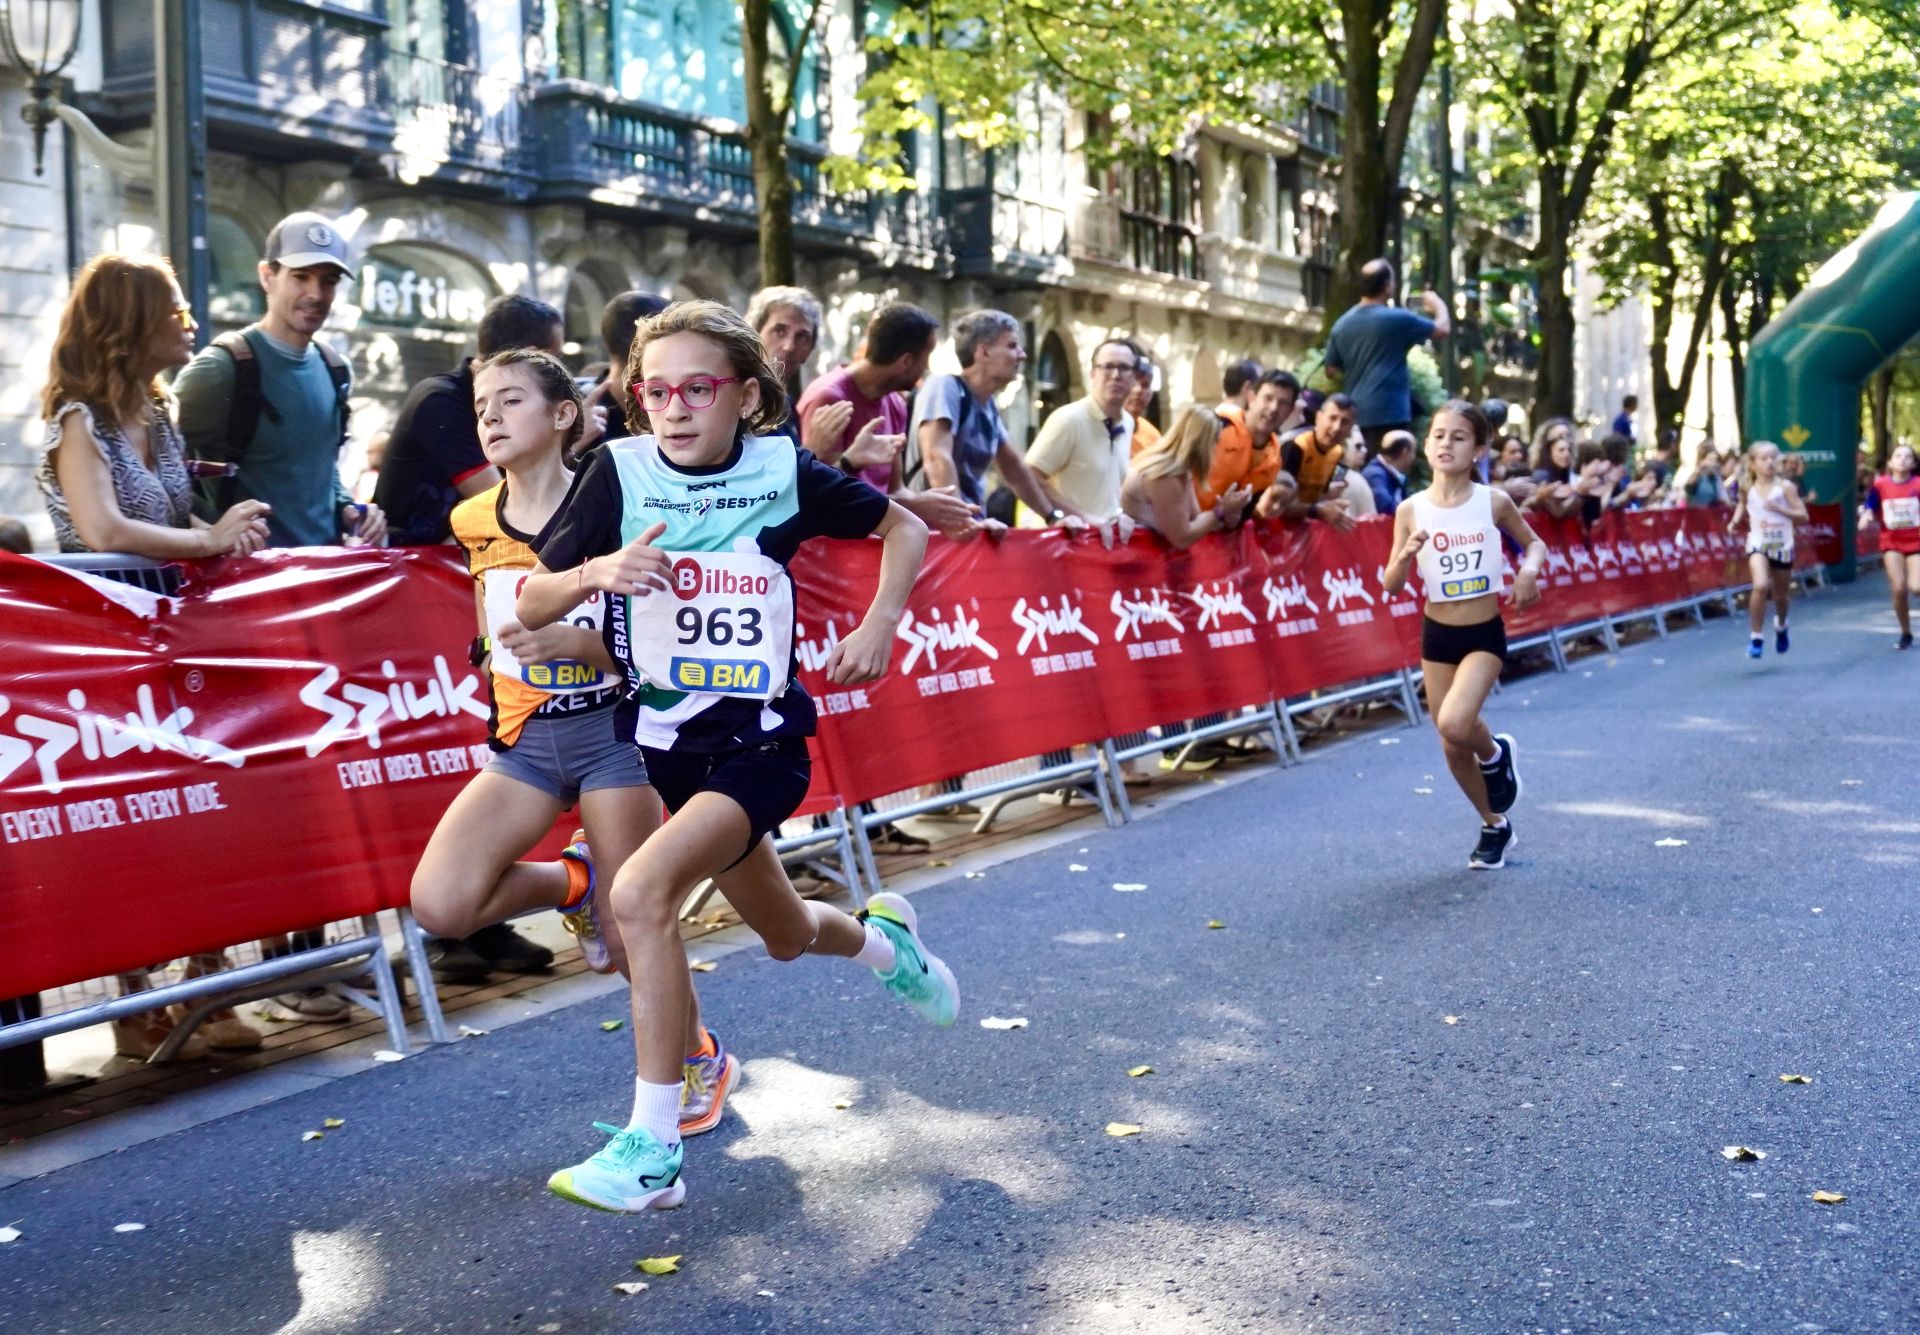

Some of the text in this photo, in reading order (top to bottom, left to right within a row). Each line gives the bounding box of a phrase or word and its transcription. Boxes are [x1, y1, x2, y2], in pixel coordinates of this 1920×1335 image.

[715, 490, 779, 509] SESTAO
[1434, 531, 1484, 551] Bilbao
[1439, 550, 1483, 575] 997
[675, 562, 769, 597] Bilbao
[1462, 577, 1487, 593] BM
[675, 606, 763, 647] 963
[556, 665, 597, 685] BM
[712, 664, 761, 689] BM
[535, 694, 588, 714] IKE
[336, 758, 383, 790] EVERY
[426, 747, 470, 776] EVERY
[1, 805, 63, 843] EVERY
[63, 797, 126, 833] RIDER.
[124, 788, 181, 824] EVERY
